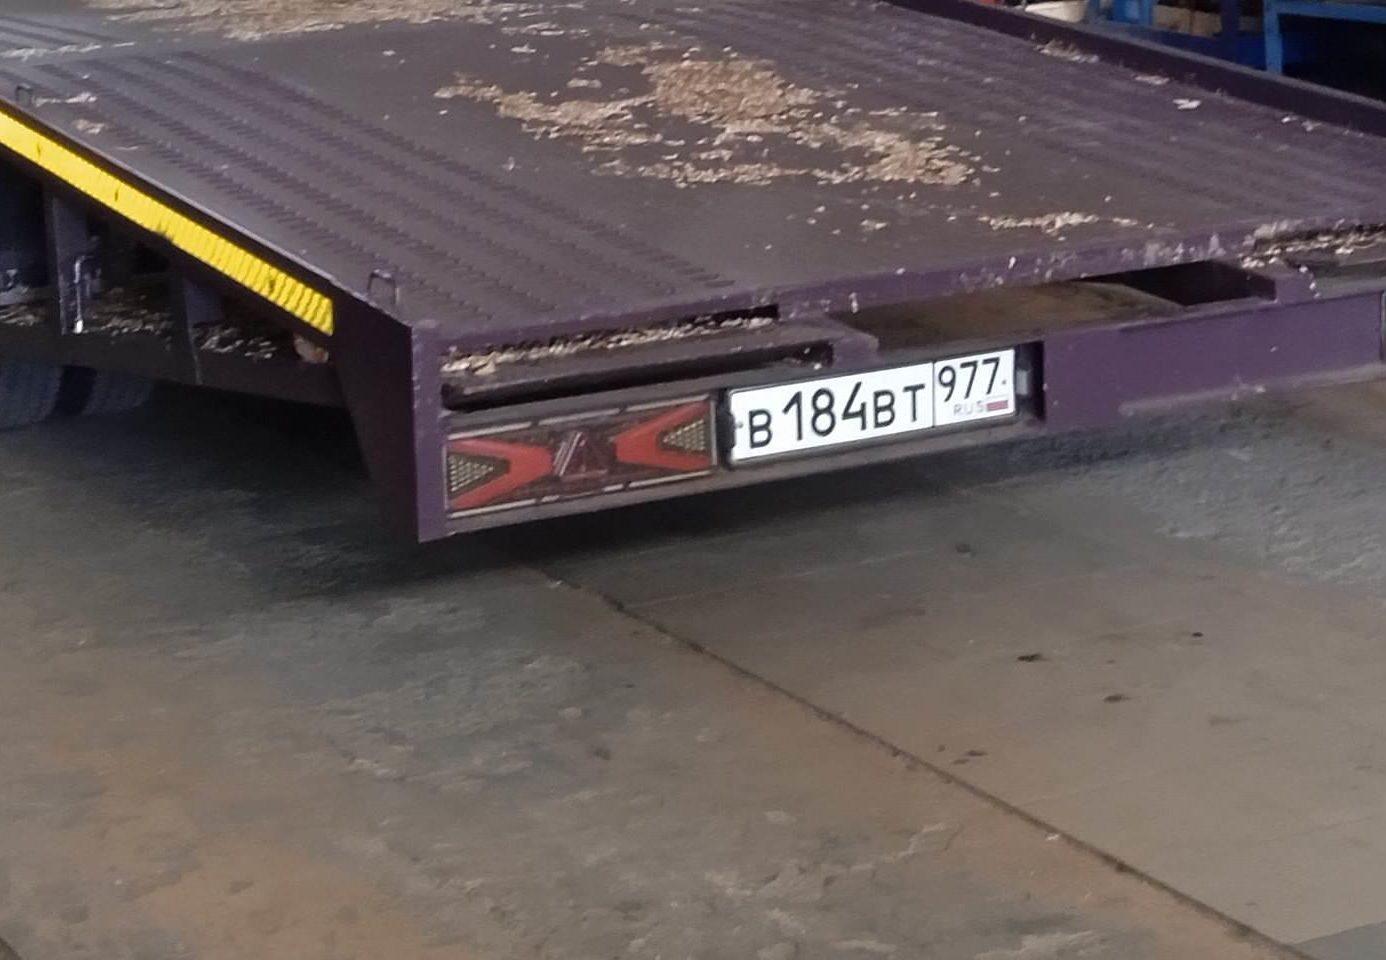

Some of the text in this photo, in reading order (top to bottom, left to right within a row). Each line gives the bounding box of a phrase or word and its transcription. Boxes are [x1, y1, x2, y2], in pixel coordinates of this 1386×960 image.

[748, 357, 1000, 449] В184ВТ 977
[953, 401, 985, 416] RUS
